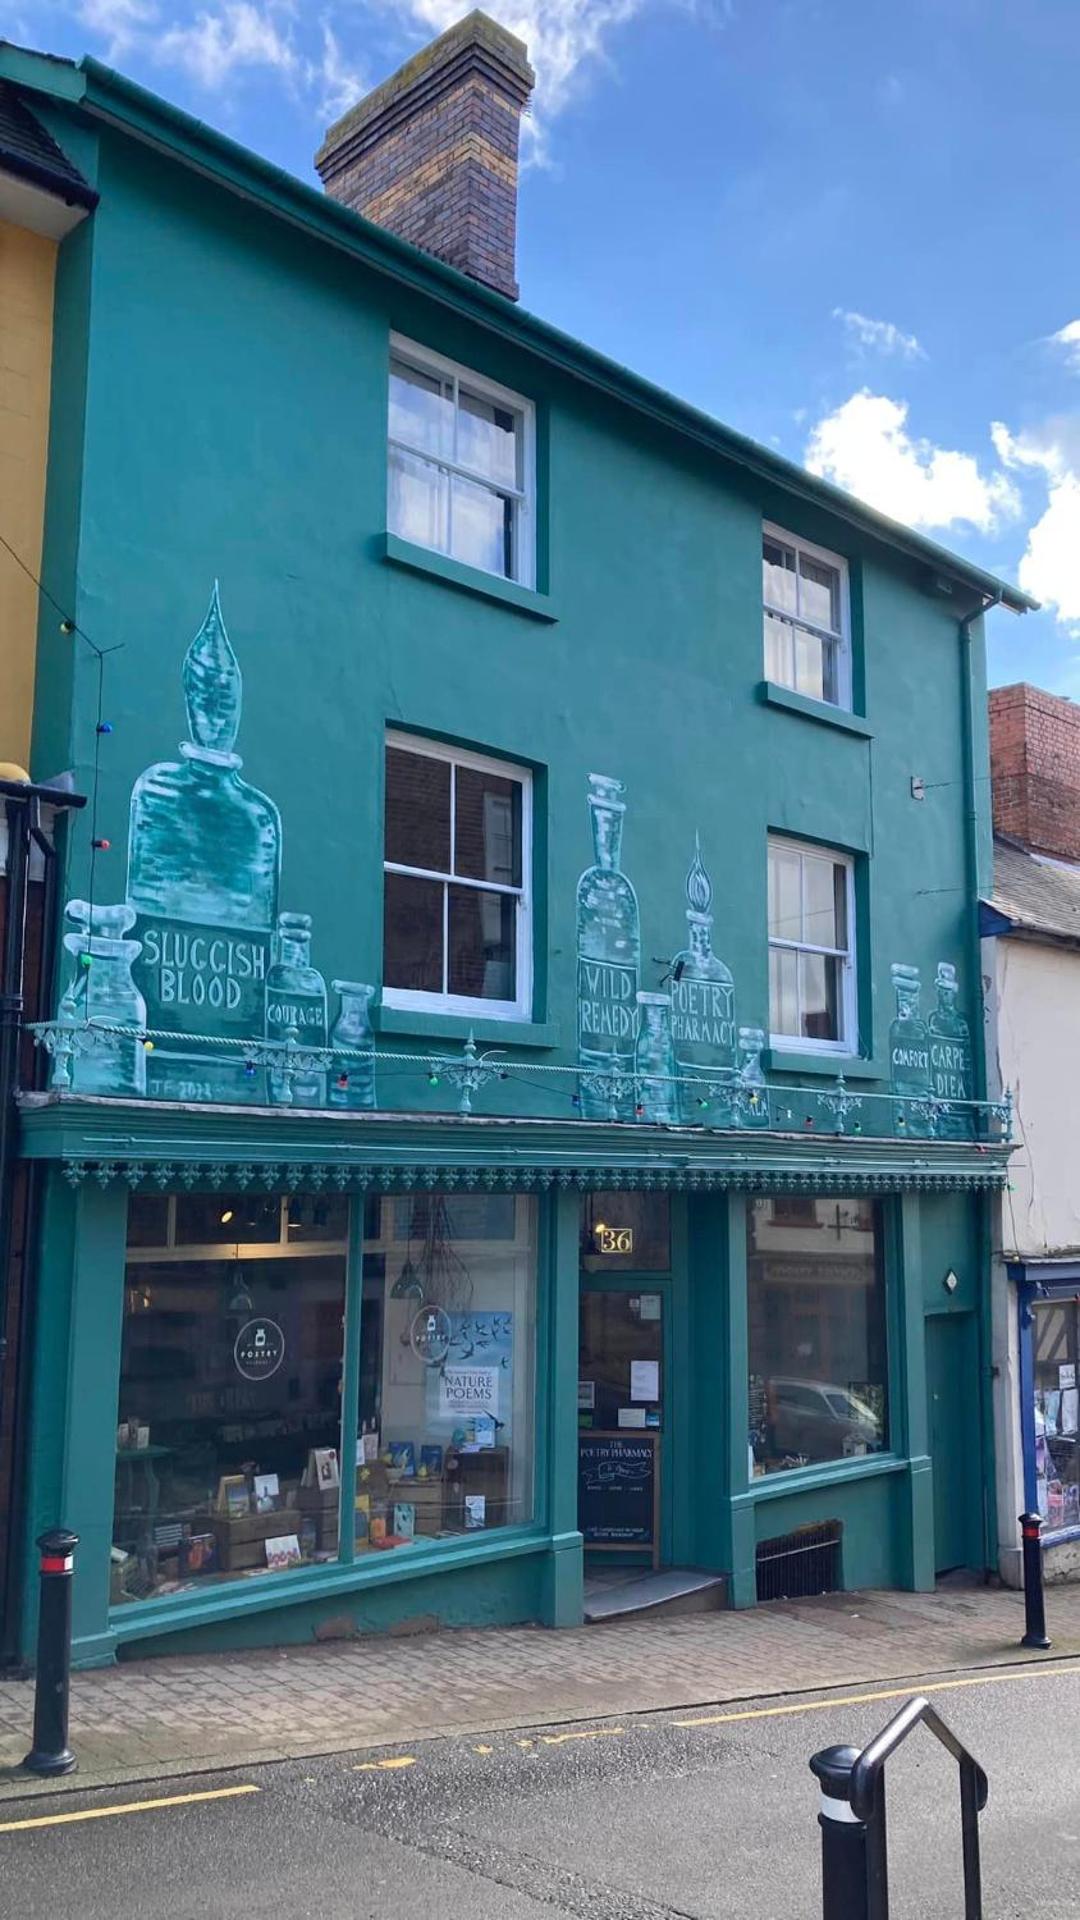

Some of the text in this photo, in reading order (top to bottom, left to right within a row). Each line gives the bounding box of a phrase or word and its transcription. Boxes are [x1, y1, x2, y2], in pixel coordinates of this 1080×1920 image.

[144, 930, 264, 979] SLUGGISH
[161, 968, 241, 1009] BLOOD
[584, 965, 632, 1000] WILD
[671, 980, 735, 1018] POETRY
[267, 1004, 324, 1026] COURAGE
[581, 1000, 640, 1040] REMEDY
[670, 1014, 735, 1047] PHARMACY
[892, 1047, 928, 1069] COMFORT
[931, 1044, 965, 1071] CARPE
[603, 1230, 630, 1250] 36
[444, 1375, 494, 1389] NATURE
[446, 1387, 493, 1400] POEMS
